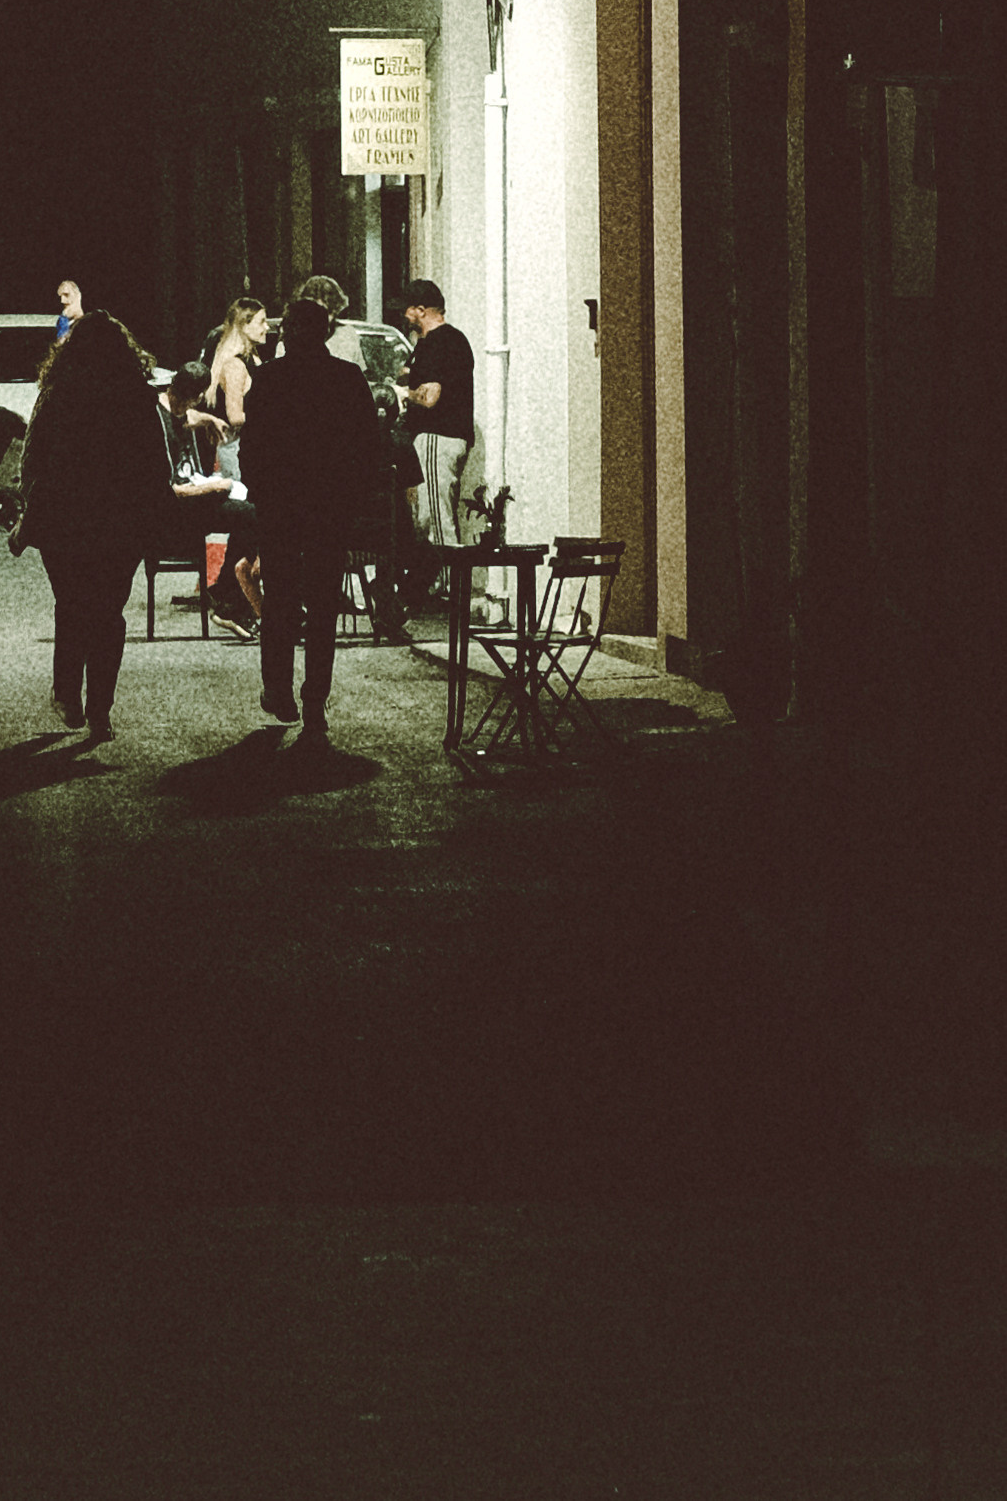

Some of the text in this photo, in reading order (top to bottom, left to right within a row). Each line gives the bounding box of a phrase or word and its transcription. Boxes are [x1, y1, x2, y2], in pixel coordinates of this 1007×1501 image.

[352, 128, 419, 145] ART GALLERY
[367, 149, 415, 165] FRAMES
